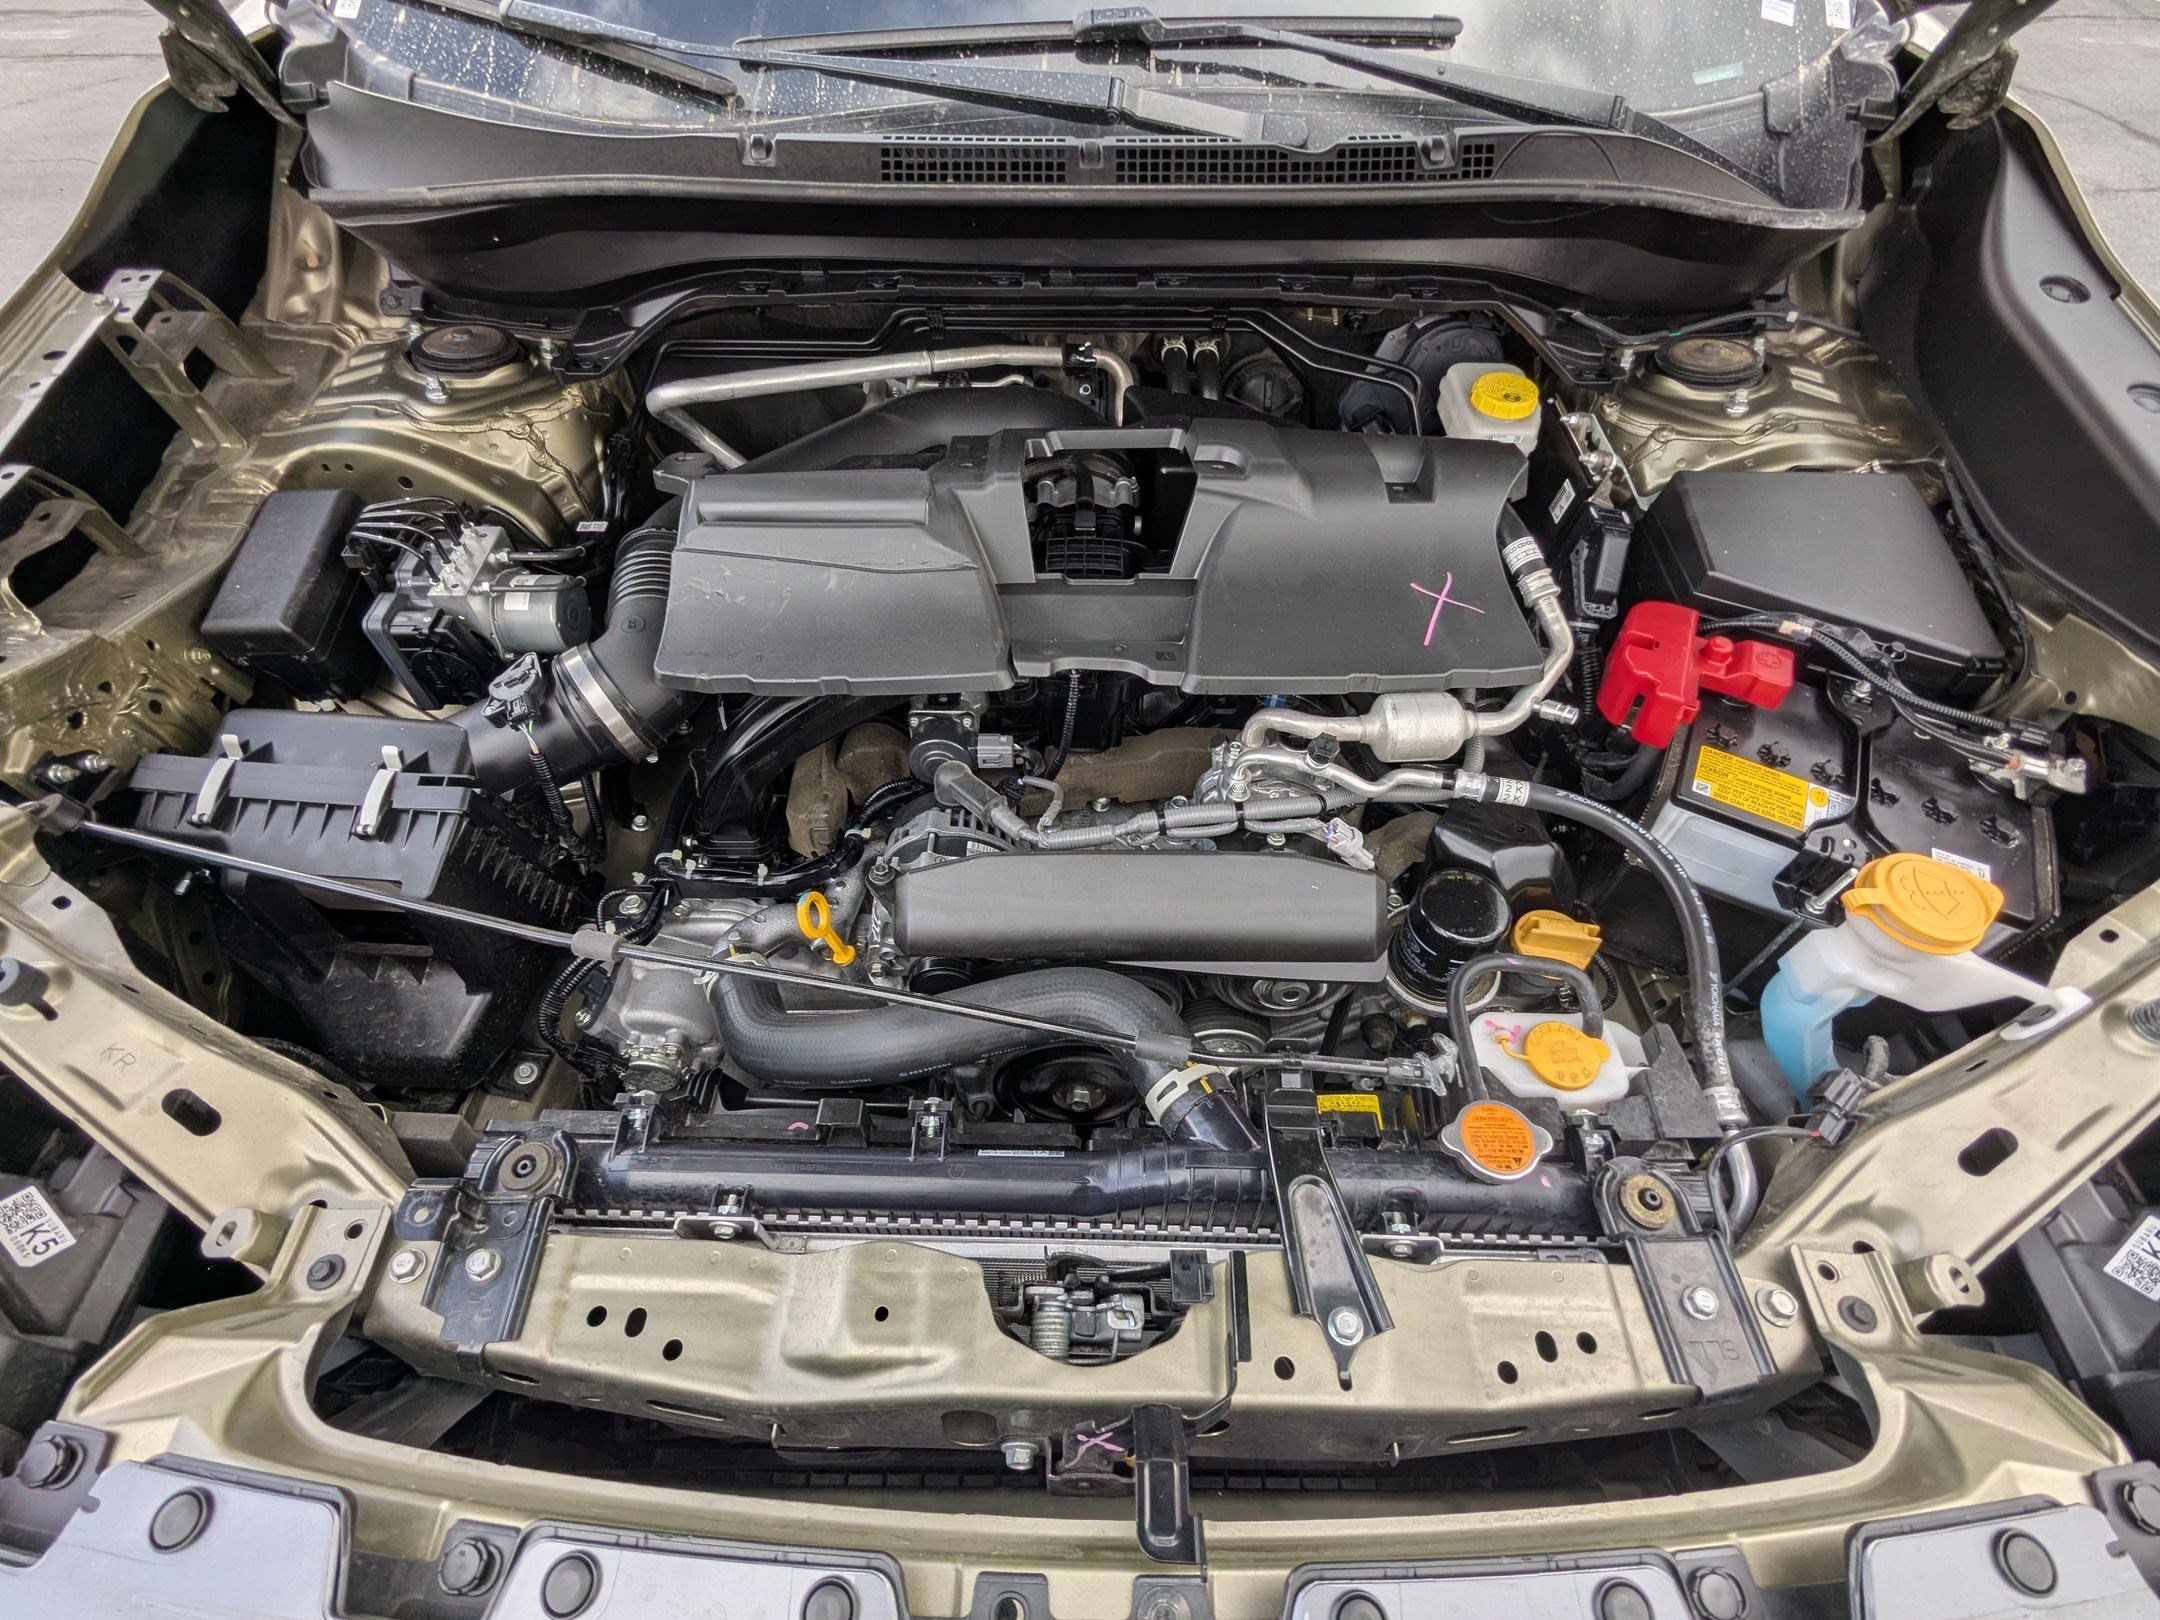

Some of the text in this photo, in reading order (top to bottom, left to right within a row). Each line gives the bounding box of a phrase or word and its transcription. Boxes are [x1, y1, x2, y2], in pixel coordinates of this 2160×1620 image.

[1703, 747, 1733, 761] DANGER
[1699, 763, 1728, 777] POISON
[1568, 792, 1611, 815] YOKOHAMA
[1709, 983, 1722, 1026] YOKOHAMA
[20, 1222, 60, 1255] K5
[46, 1217, 67, 1244] SUBARU
